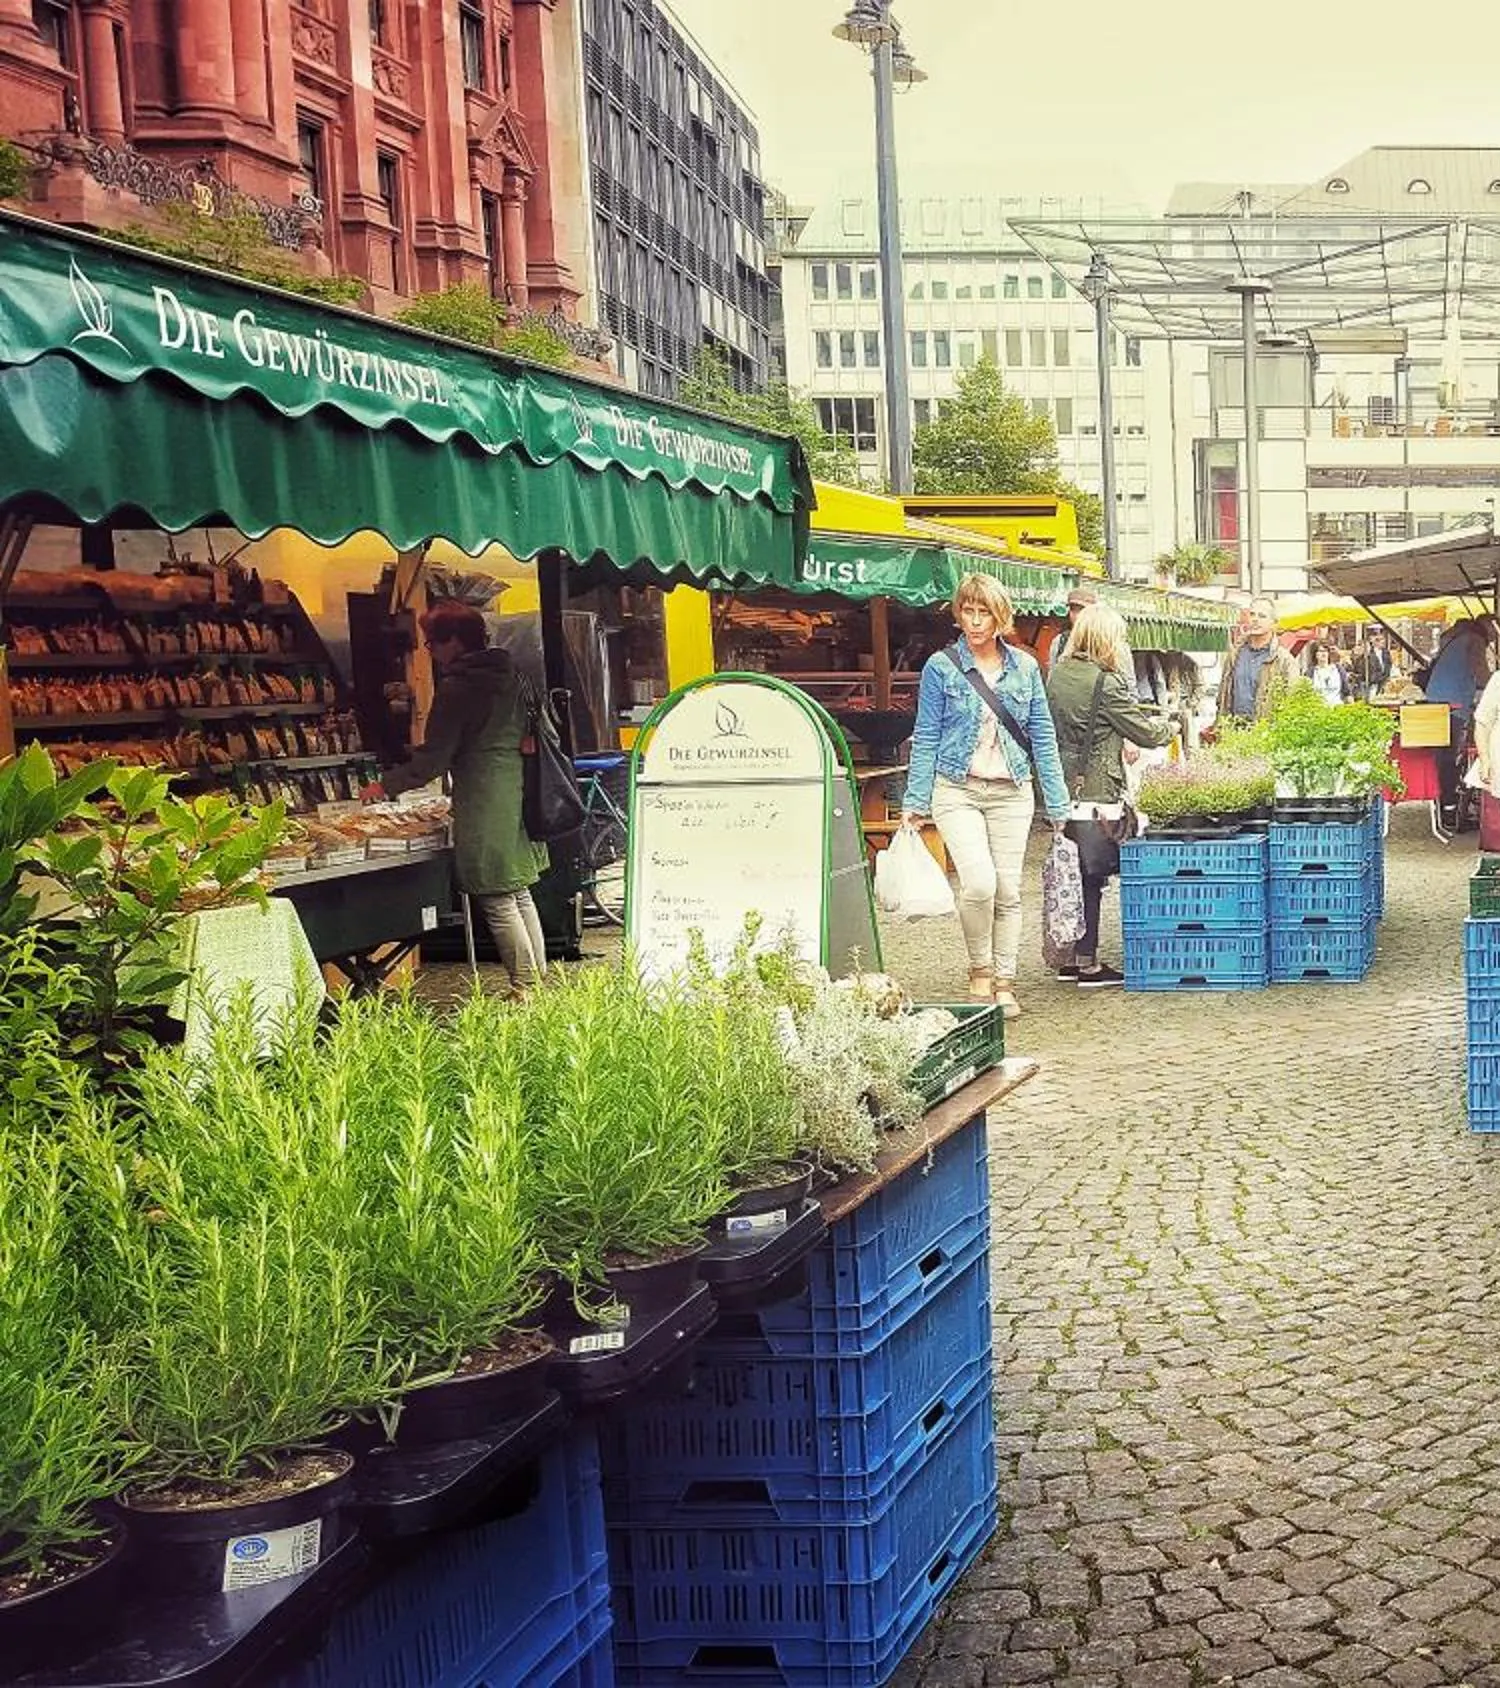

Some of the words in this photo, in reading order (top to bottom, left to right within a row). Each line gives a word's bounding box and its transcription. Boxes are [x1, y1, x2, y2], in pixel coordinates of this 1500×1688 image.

[152, 285, 224, 359] DIE
[232, 309, 449, 407] GEWÜRZINSEL
[609, 405, 646, 451] DIE
